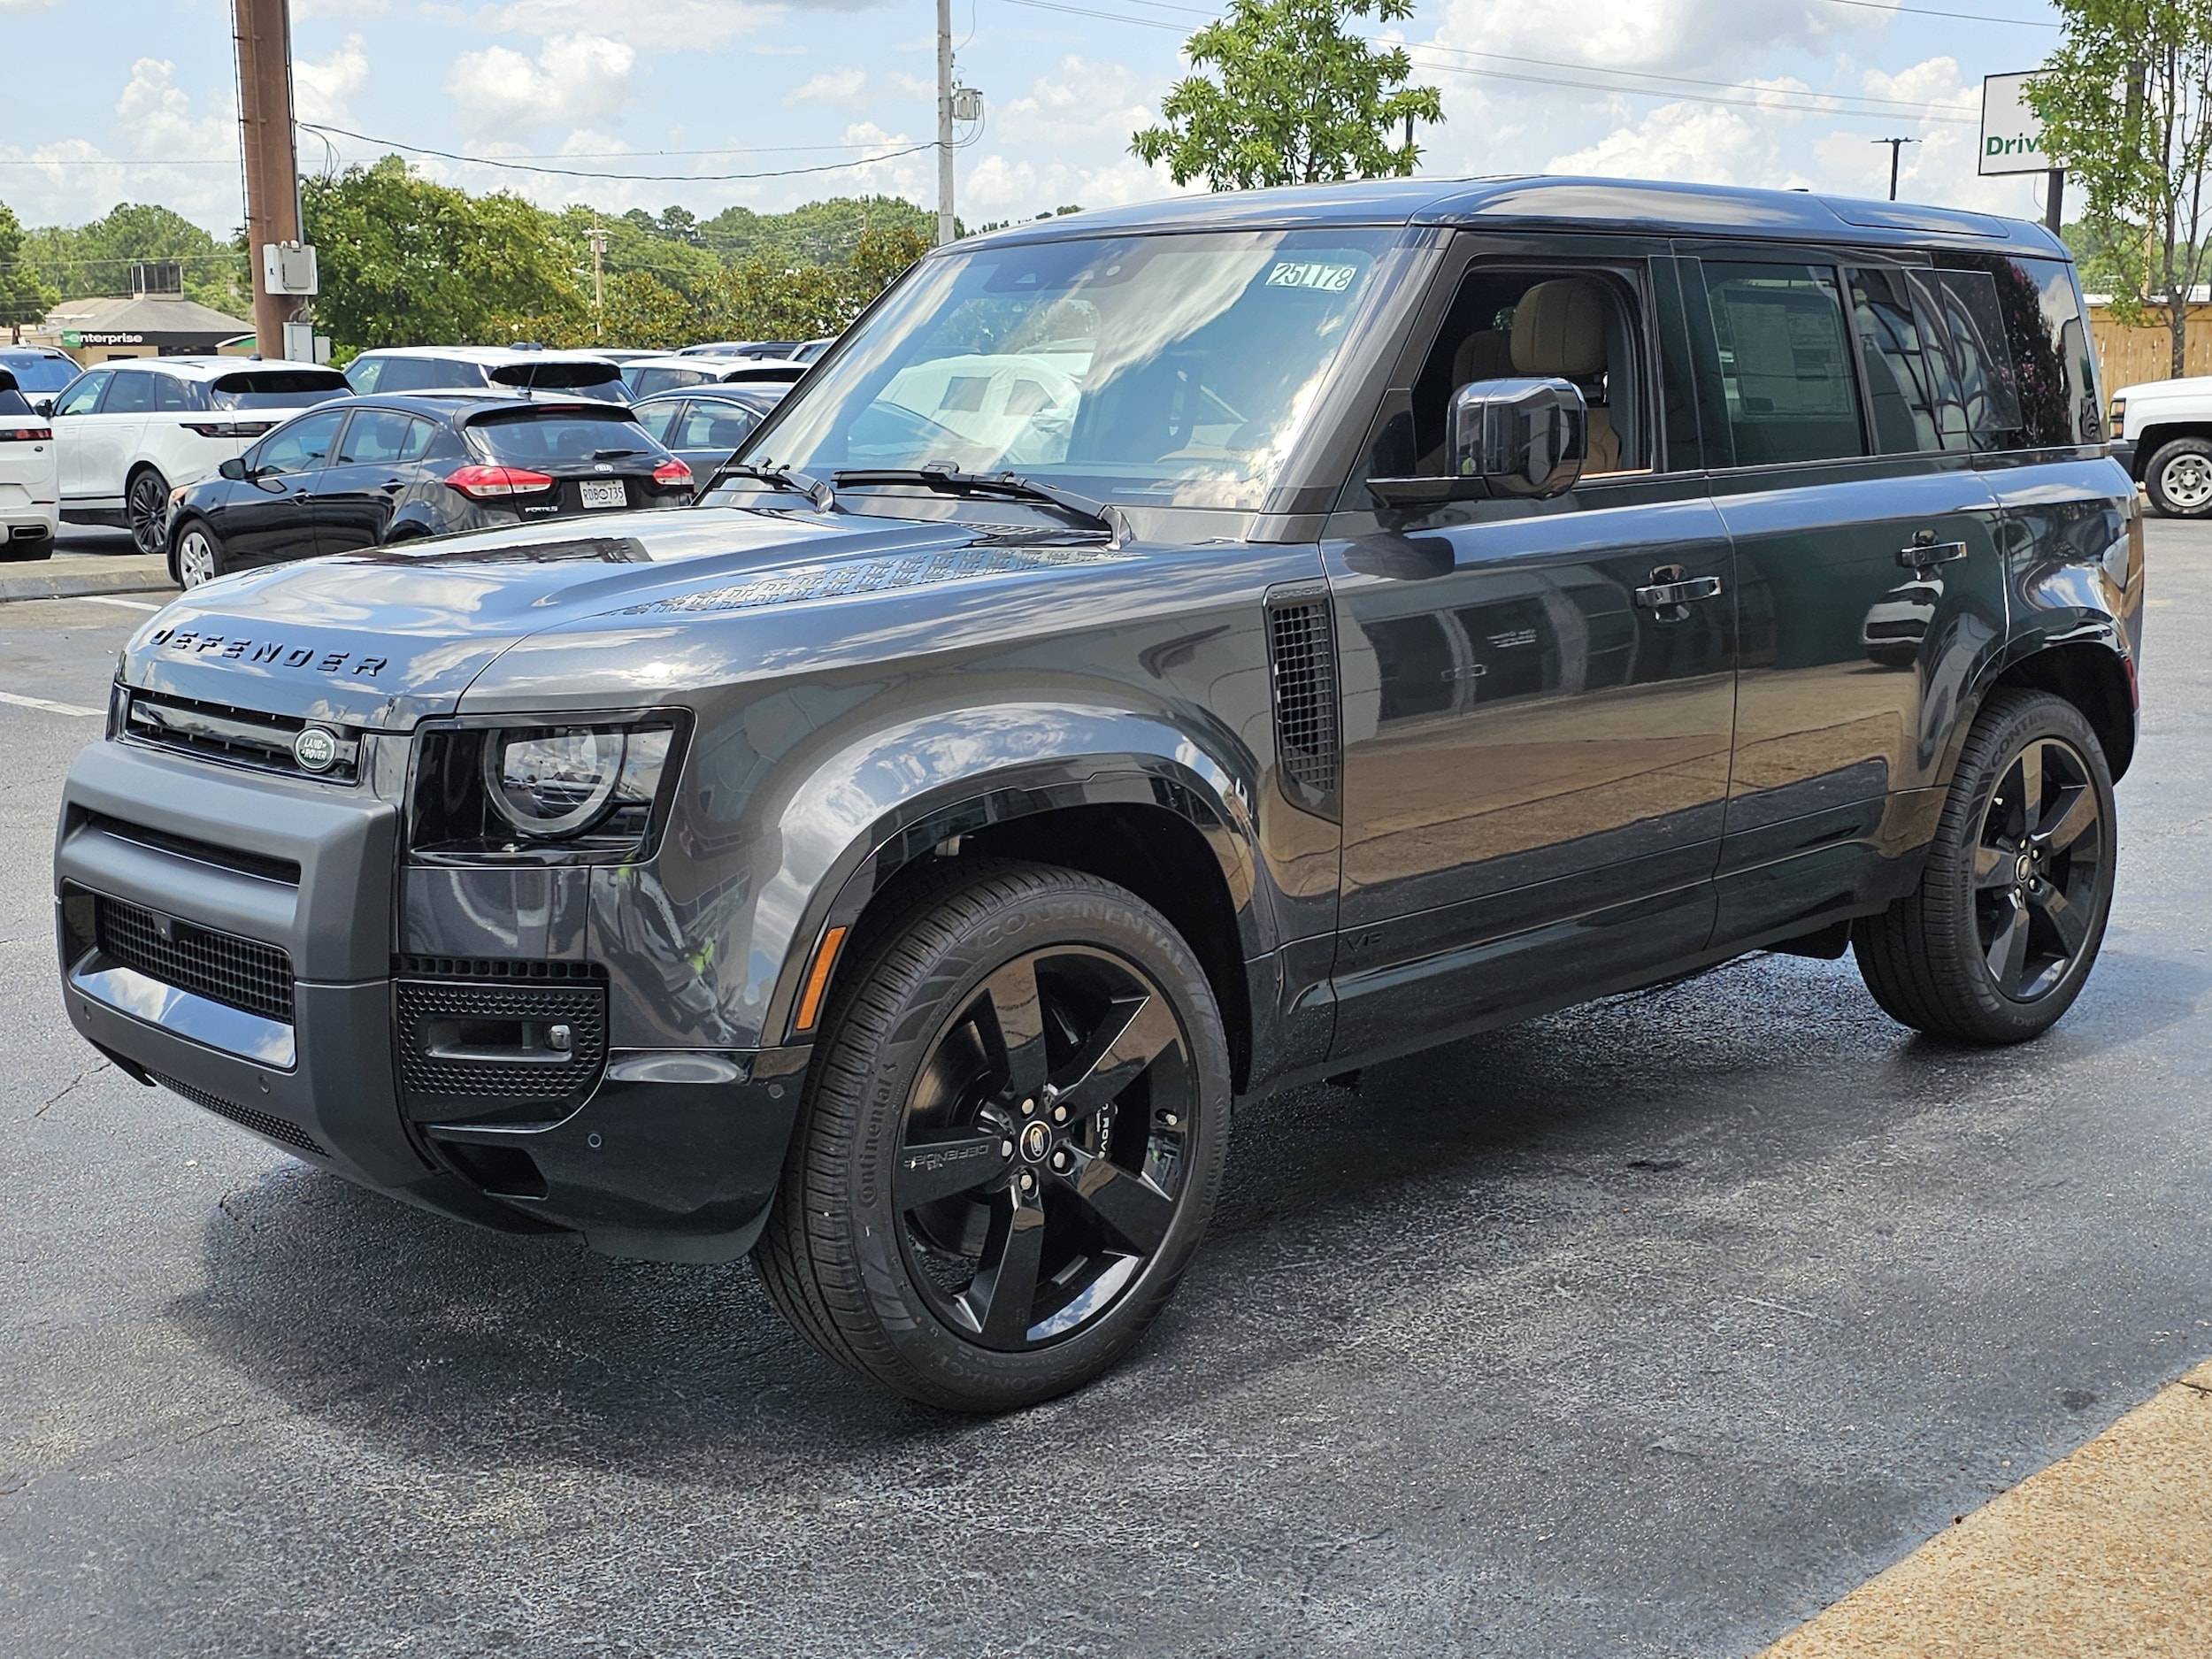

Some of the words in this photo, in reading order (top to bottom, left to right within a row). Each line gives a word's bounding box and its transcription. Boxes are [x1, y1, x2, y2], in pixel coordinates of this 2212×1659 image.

[67, 333, 143, 345] enterprise
[150, 629, 388, 677] DEFENDER
[304, 737, 323, 749] LAND
[303, 748, 326, 761] ROVER
